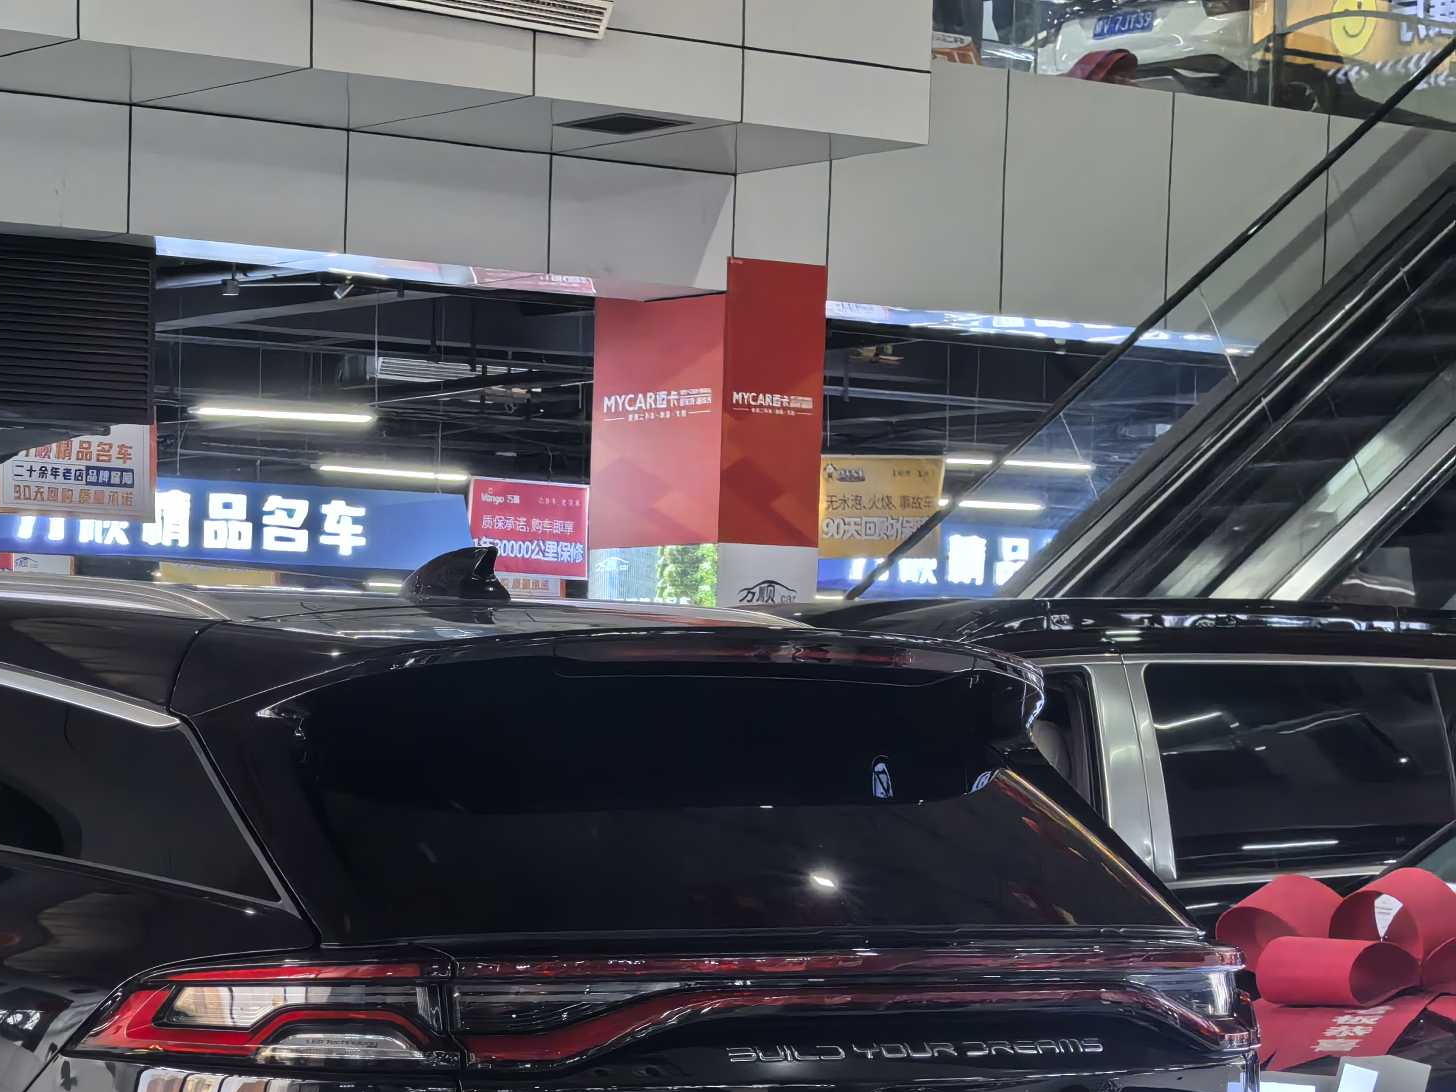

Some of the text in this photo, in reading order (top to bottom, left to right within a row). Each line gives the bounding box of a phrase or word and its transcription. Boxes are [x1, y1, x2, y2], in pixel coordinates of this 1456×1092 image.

[725, 1037, 1104, 1063] BUILD YOUR DREAMS
